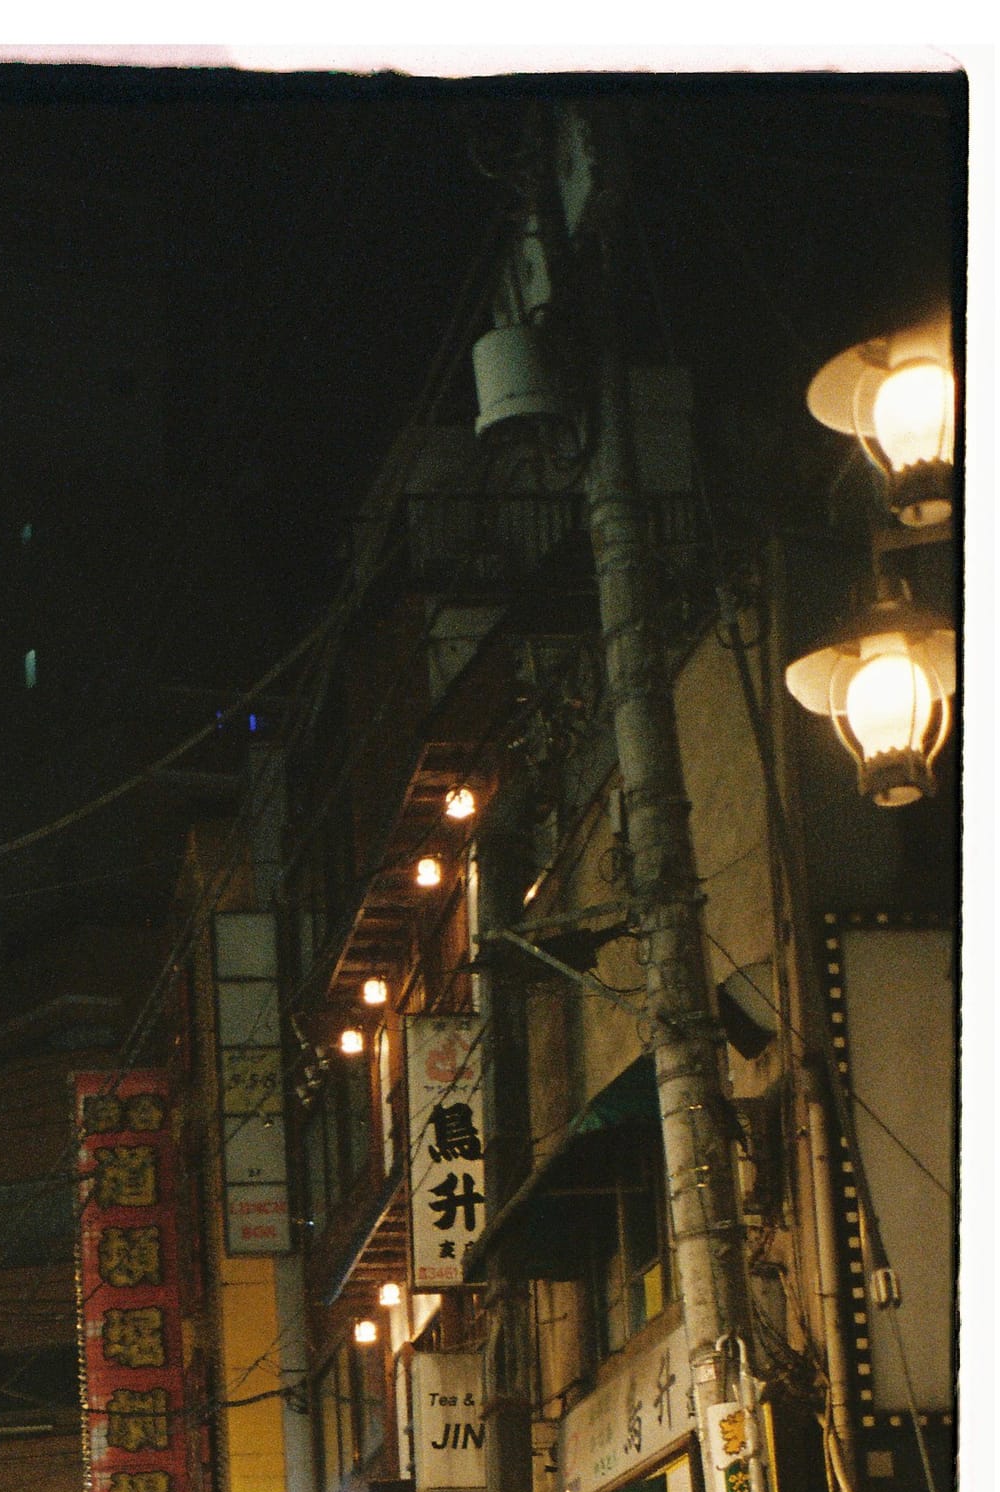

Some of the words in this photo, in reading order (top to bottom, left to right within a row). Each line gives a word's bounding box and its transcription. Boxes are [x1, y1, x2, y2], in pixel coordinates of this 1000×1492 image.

[428, 1102, 484, 1232] 鳥升
[428, 1392, 458, 1406] Tea
[464, 1392, 475, 1406] &
[431, 1423, 486, 1449] JIN
